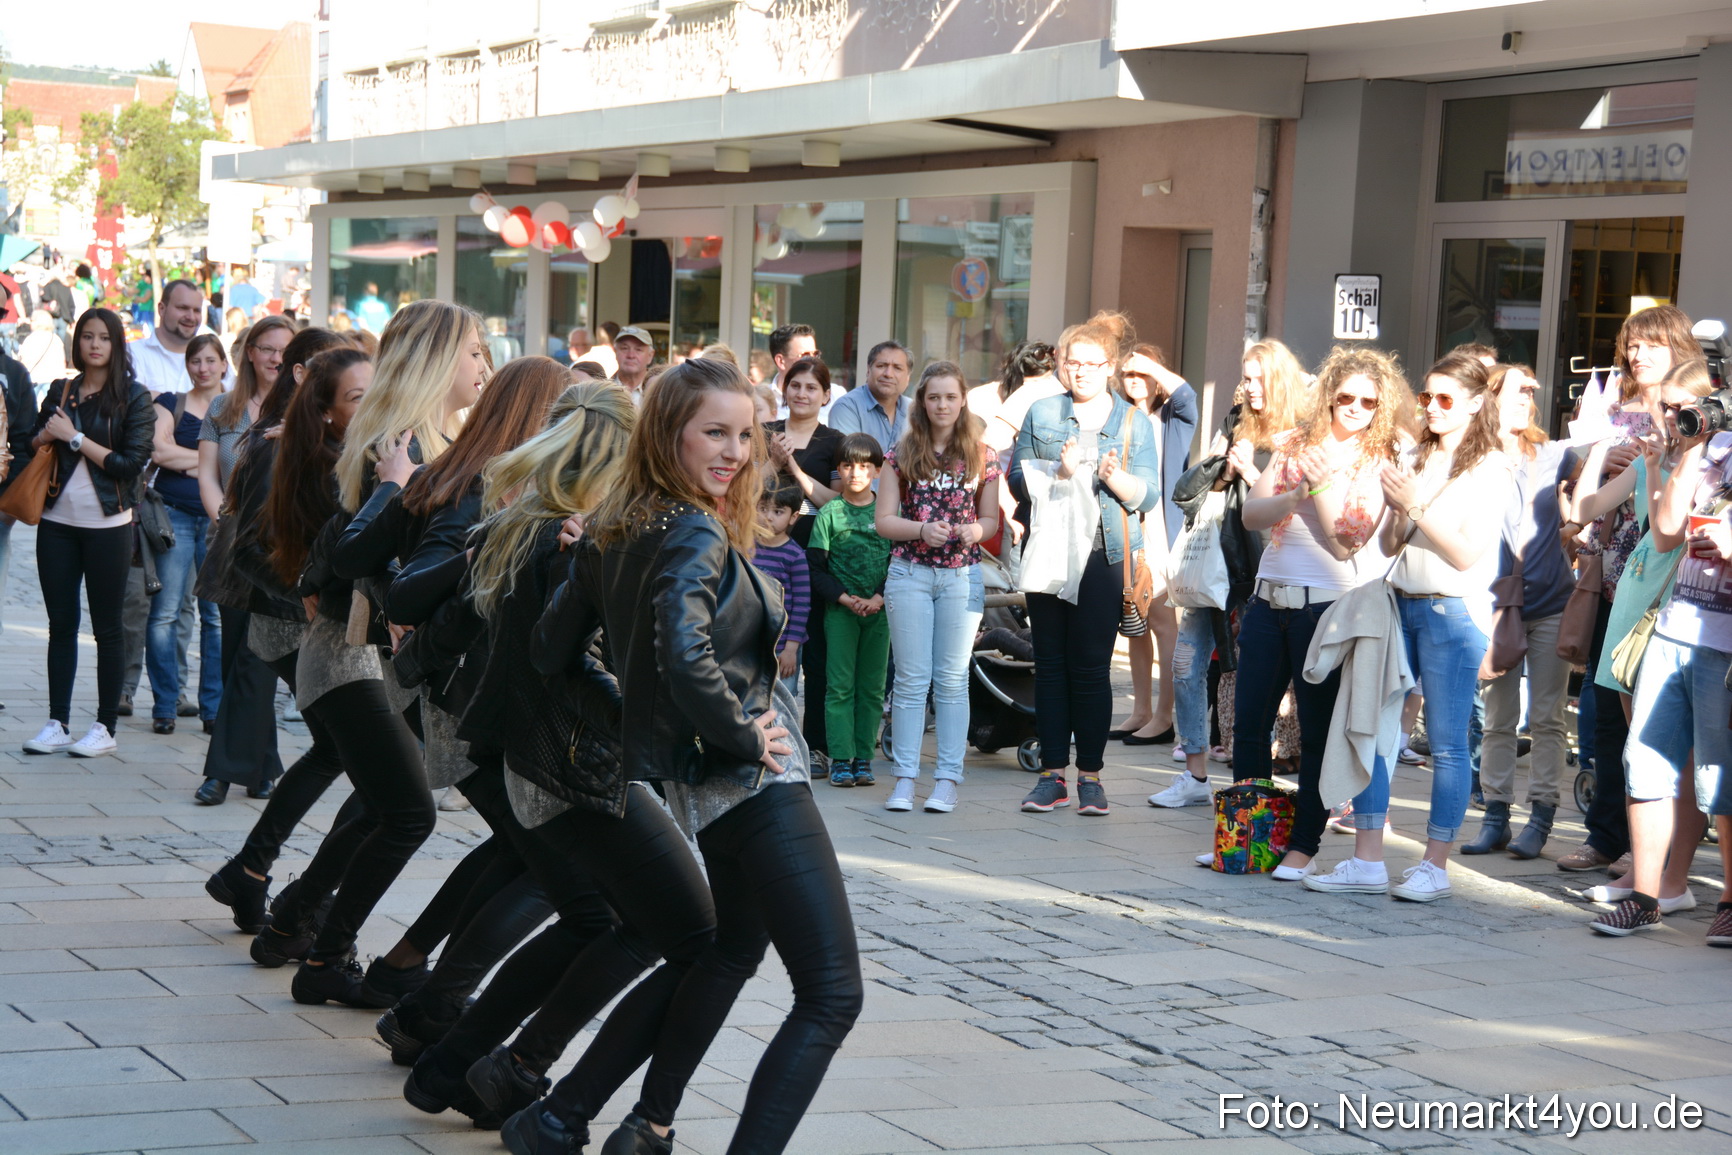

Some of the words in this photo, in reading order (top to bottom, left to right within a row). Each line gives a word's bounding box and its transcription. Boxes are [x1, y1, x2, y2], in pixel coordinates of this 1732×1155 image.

[1338, 288, 1378, 307] Schal
[1680, 586, 1690, 597] HAS
[1690, 589, 1695, 598] A
[1695, 590, 1716, 602] STORY
